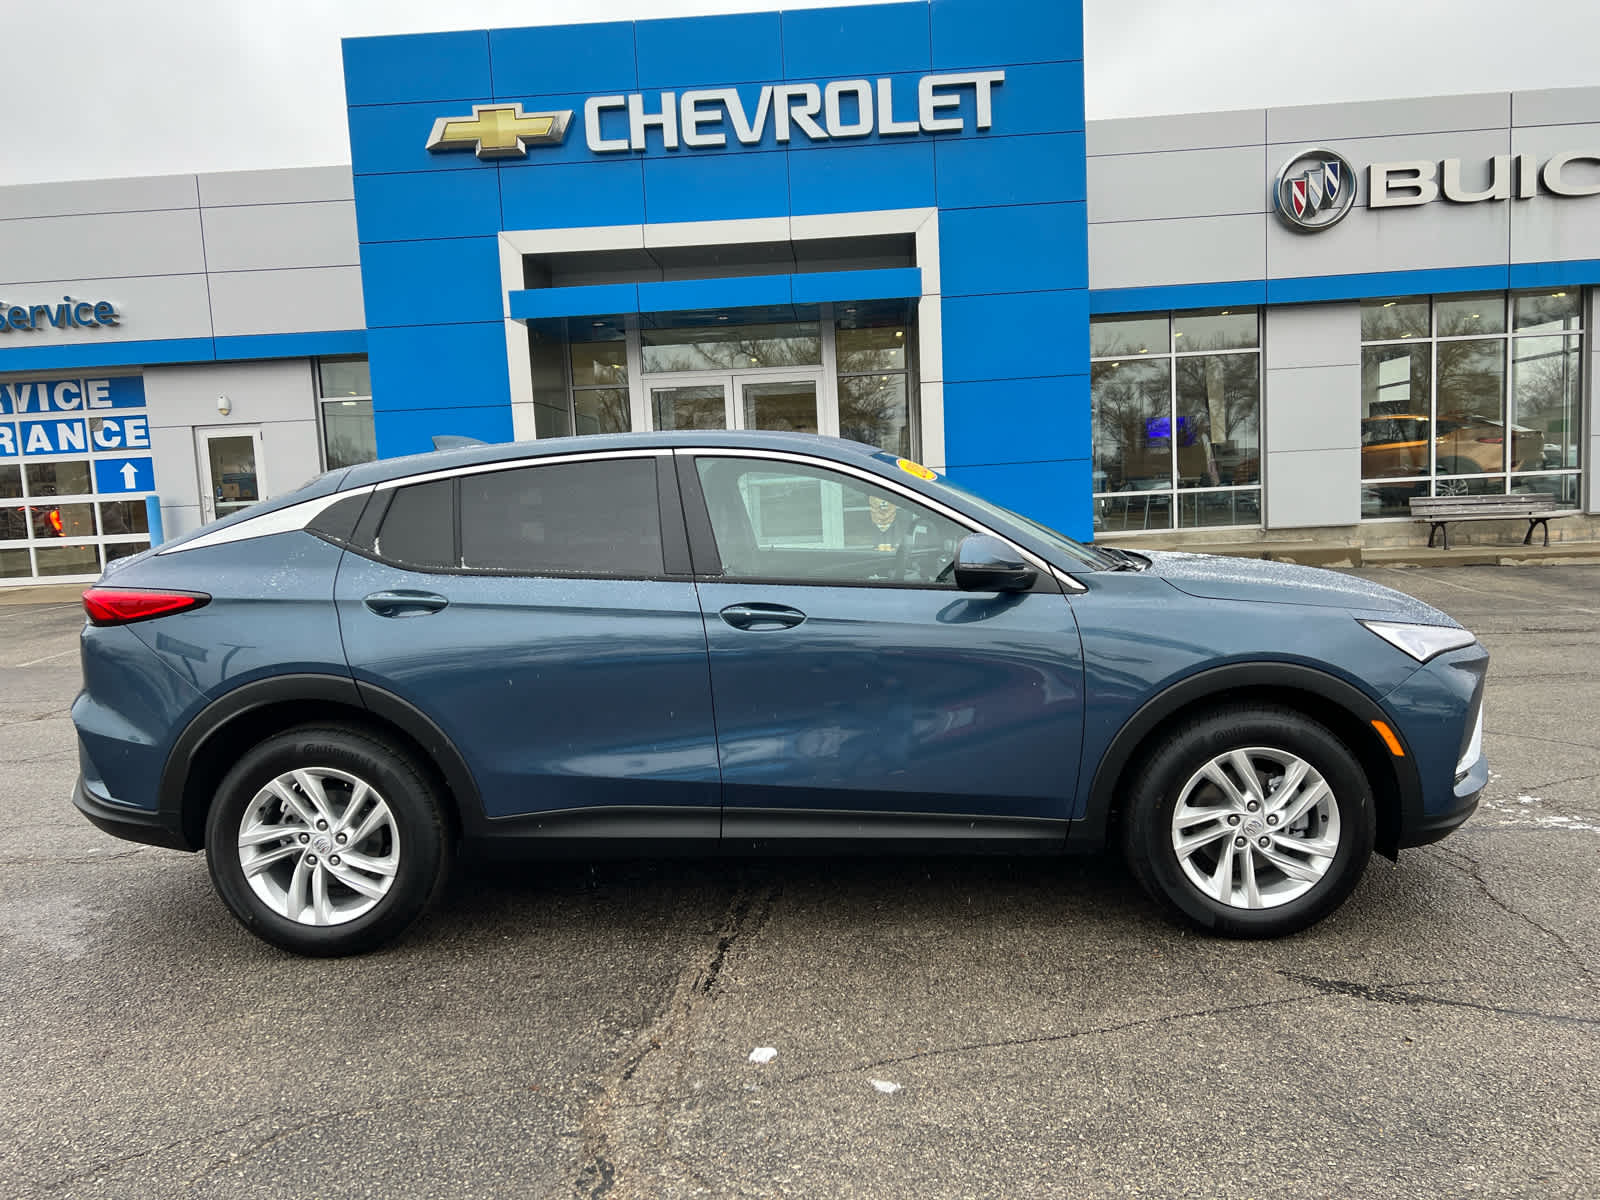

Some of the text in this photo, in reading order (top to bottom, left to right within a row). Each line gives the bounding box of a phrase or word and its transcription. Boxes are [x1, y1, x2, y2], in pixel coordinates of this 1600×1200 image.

[583, 70, 1006, 154] CHEVROLET
[1367, 151, 1600, 208] BUIC
[0, 380, 113, 414] VICE
